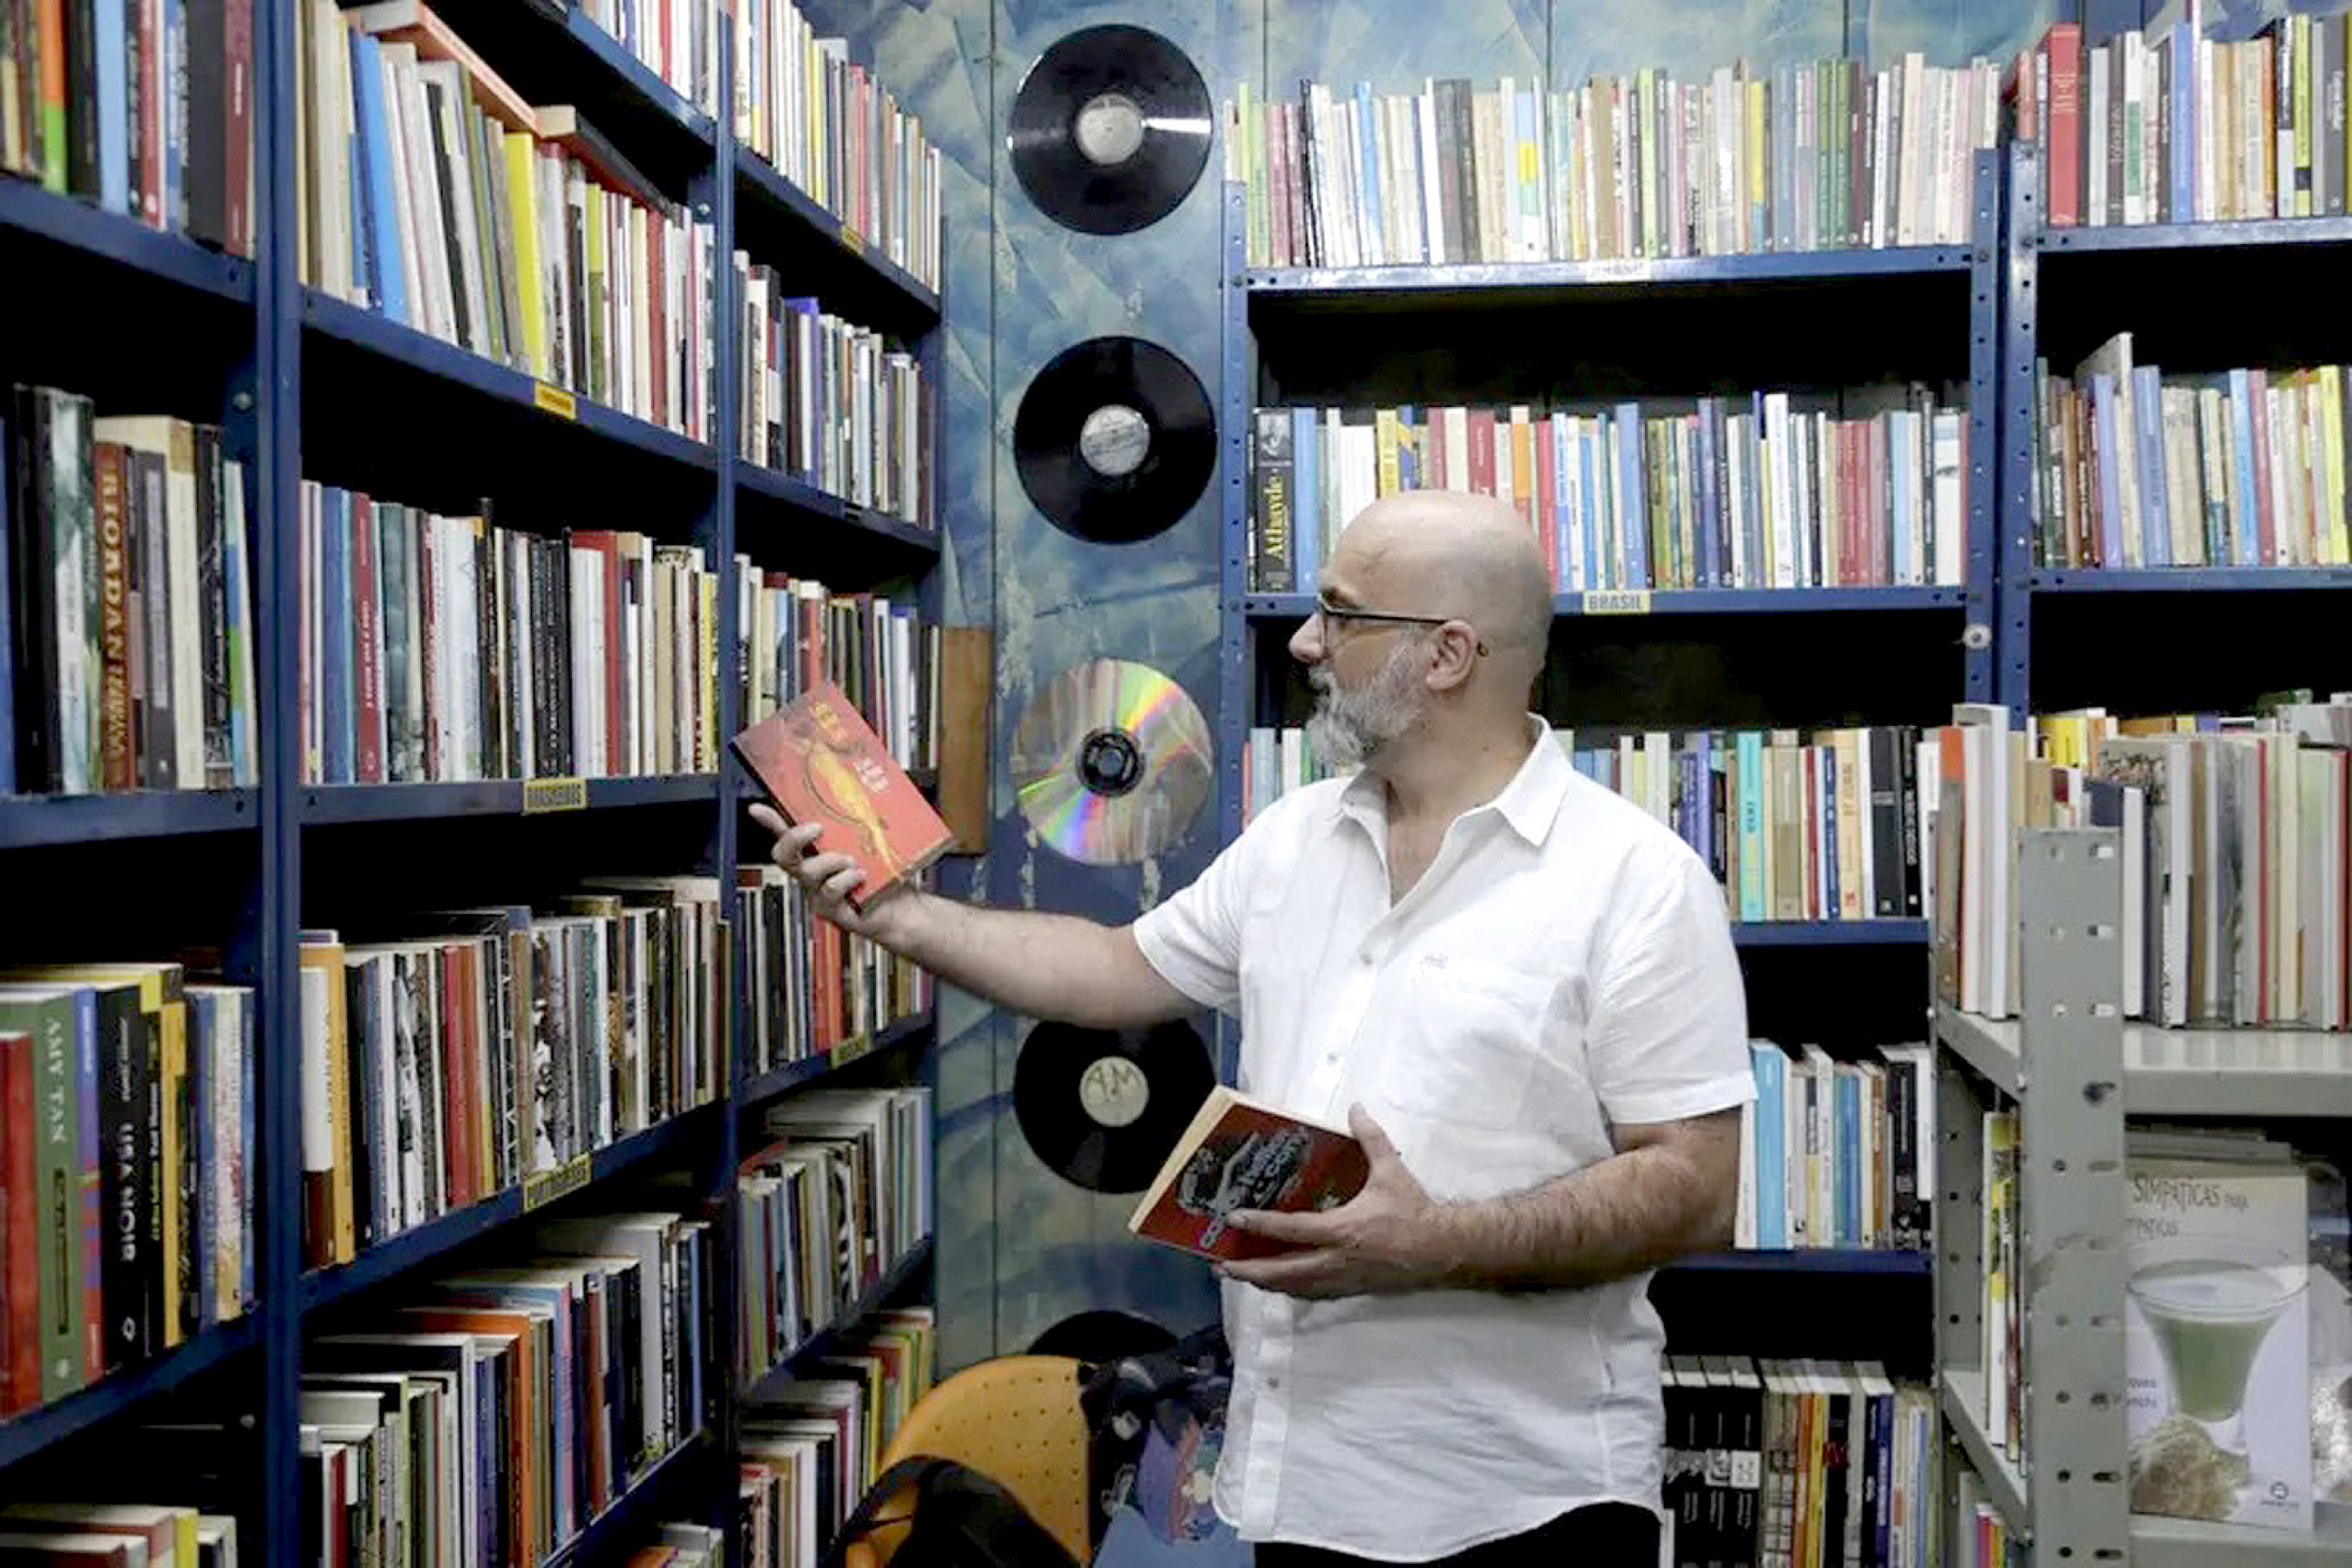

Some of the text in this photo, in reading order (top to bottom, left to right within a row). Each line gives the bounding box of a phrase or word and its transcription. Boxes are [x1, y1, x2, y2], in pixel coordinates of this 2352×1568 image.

[102, 470, 125, 660] RIORDAN
[1588, 594, 1643, 611] BRASIL
[46, 1017, 68, 1144] AMY TAN
[118, 1122, 137, 1262] USA NOIR
